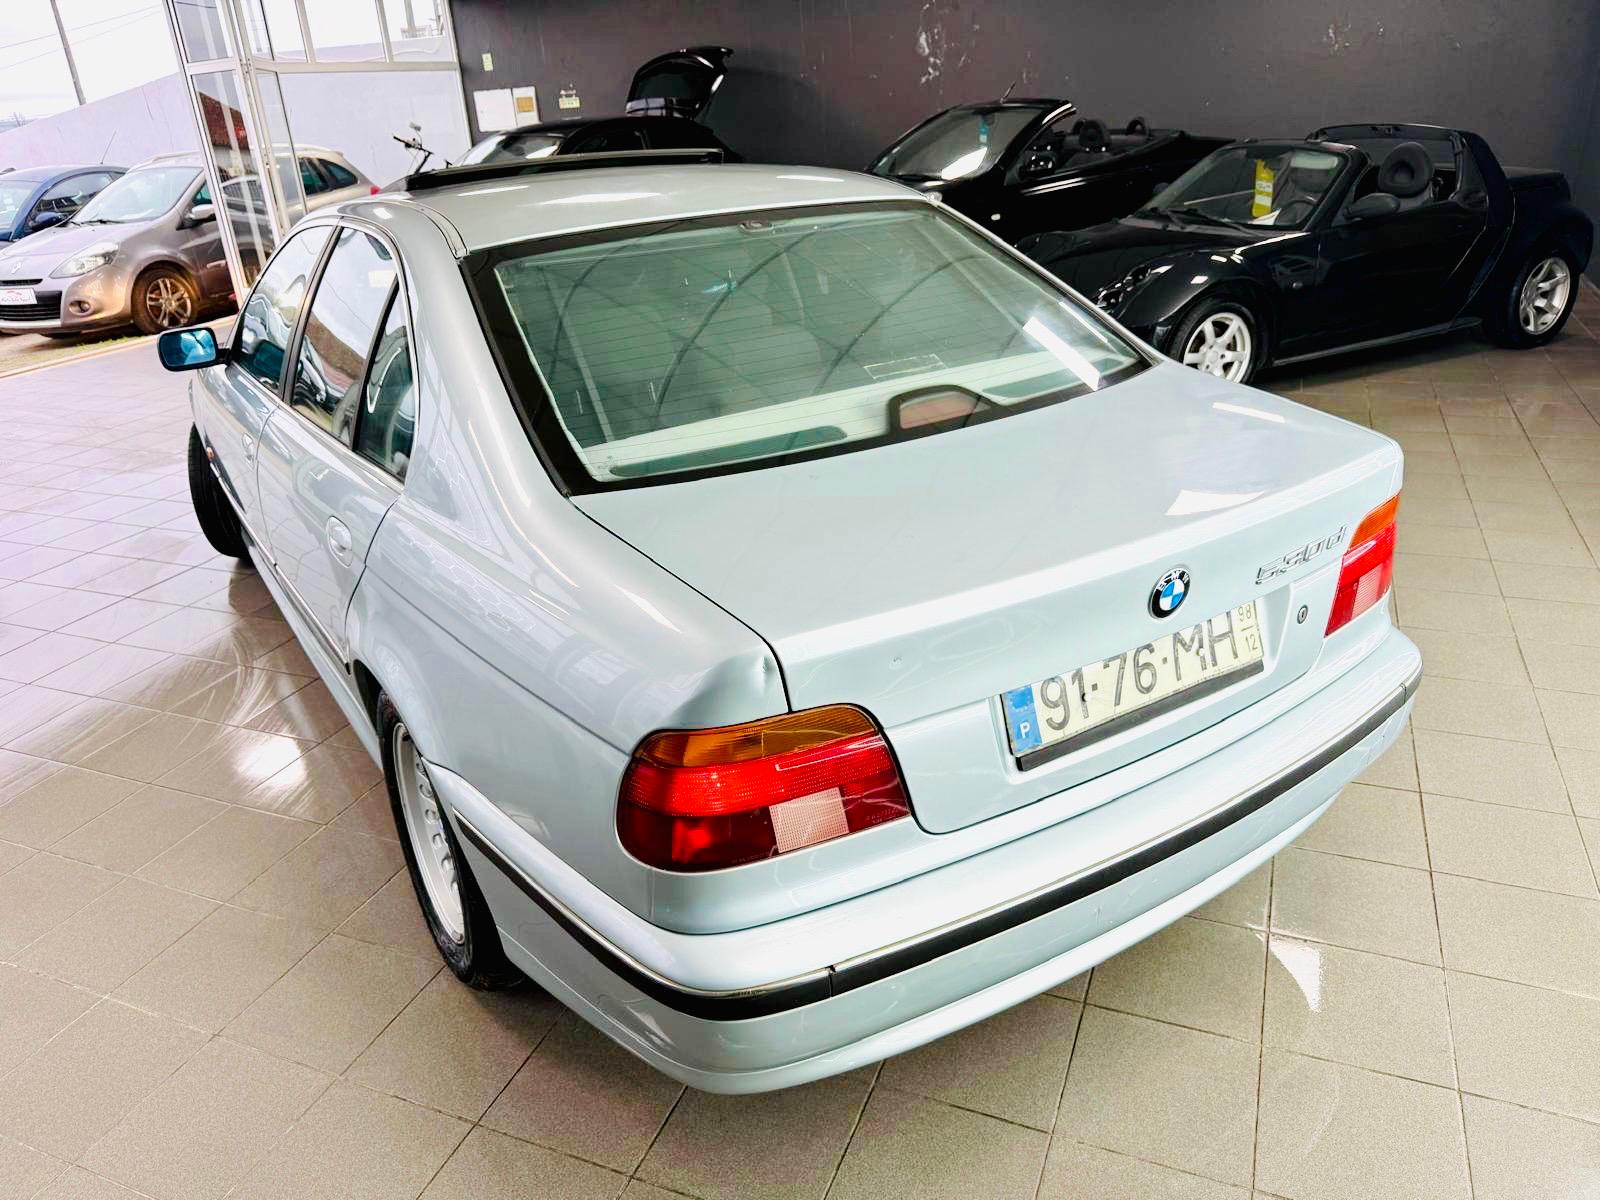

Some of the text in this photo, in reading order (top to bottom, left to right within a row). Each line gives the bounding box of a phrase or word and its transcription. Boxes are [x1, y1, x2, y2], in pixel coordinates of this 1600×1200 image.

[1156, 569, 1190, 591] BMW
[1238, 604, 1252, 622] 98
[1245, 634, 1259, 653] 12
[1020, 721, 1031, 739] P
